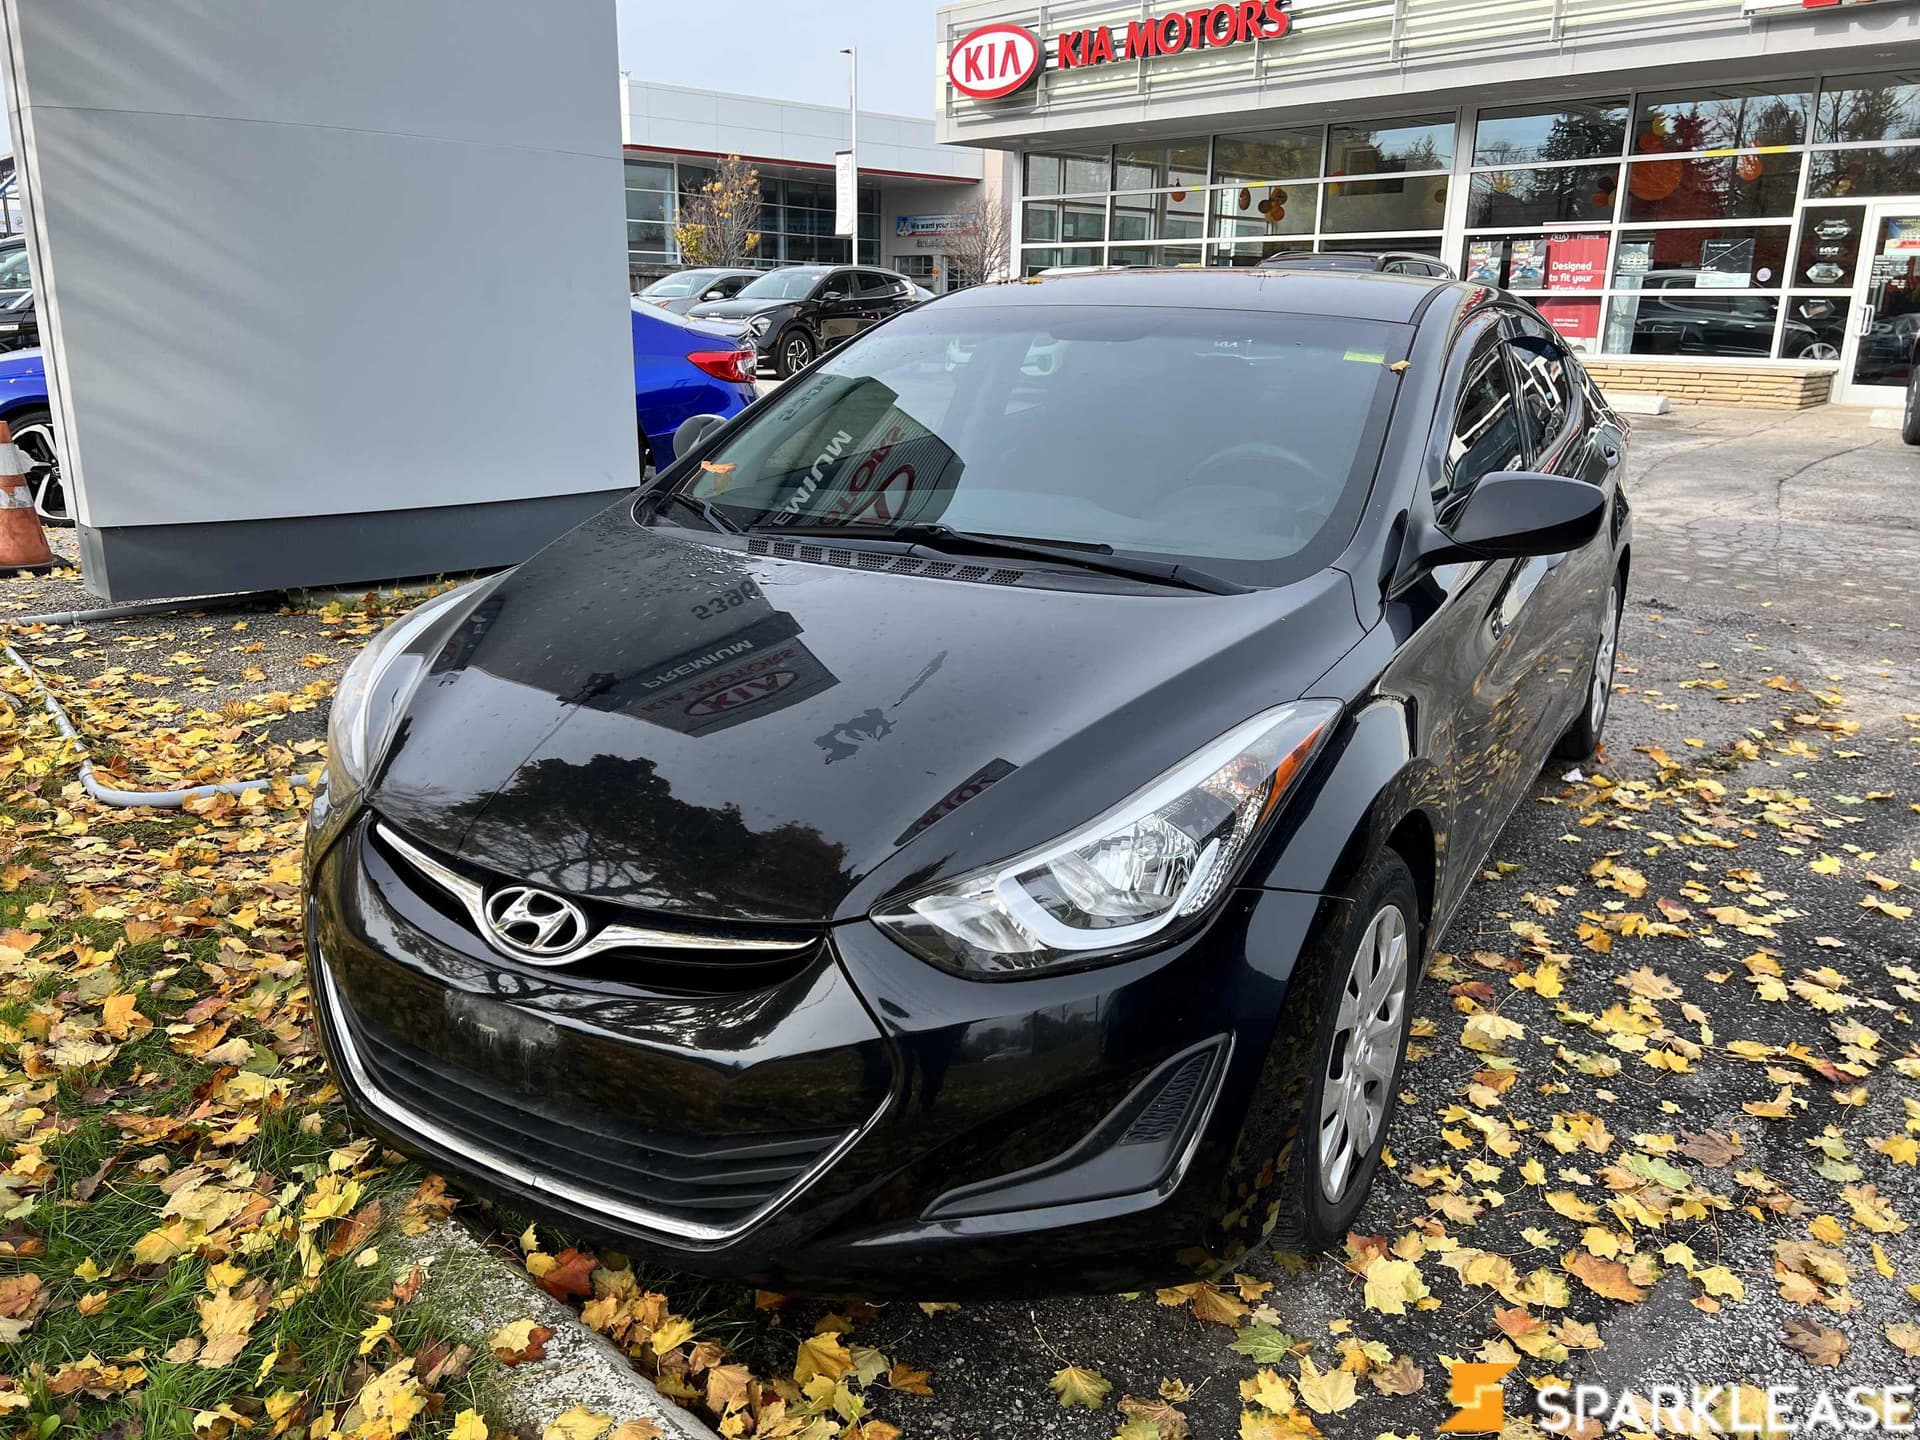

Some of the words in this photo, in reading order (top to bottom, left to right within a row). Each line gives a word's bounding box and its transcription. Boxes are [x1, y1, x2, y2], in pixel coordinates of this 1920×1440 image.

[1058, 26, 1115, 69] KIA
[1125, 0, 1293, 60] MOTORS
[964, 40, 1022, 82] KIA
[920, 222, 935, 230] want
[935, 222, 949, 231] your
[1552, 261, 1592, 272] Designed
[1549, 274, 1558, 282] to
[1560, 273, 1571, 282] fit
[1572, 275, 1593, 284] your
